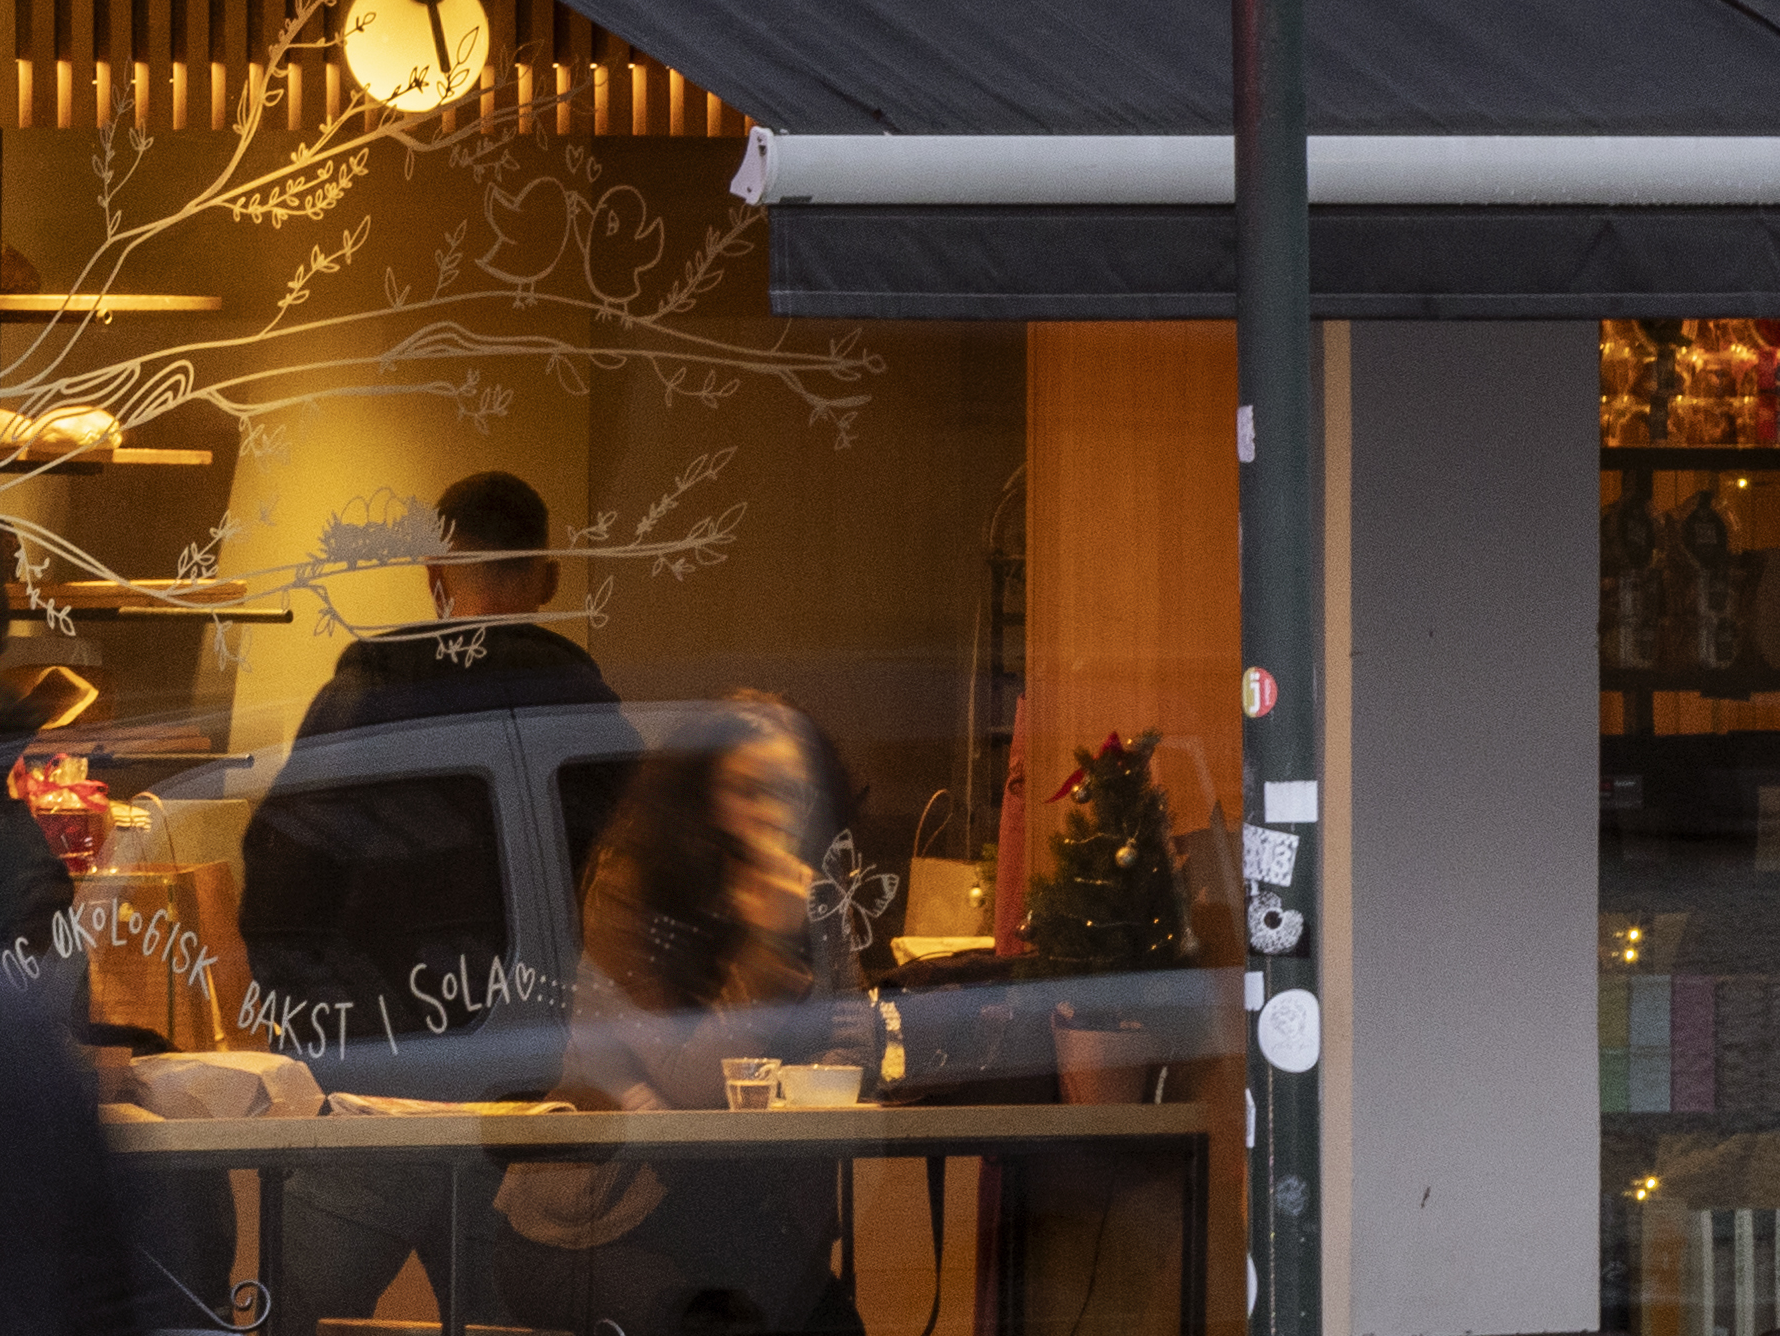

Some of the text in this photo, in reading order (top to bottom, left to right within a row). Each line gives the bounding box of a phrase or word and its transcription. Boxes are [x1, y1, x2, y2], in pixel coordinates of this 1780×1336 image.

[1, 898, 510, 1060] OG ØKOLOGISK BAKST I SOLA
